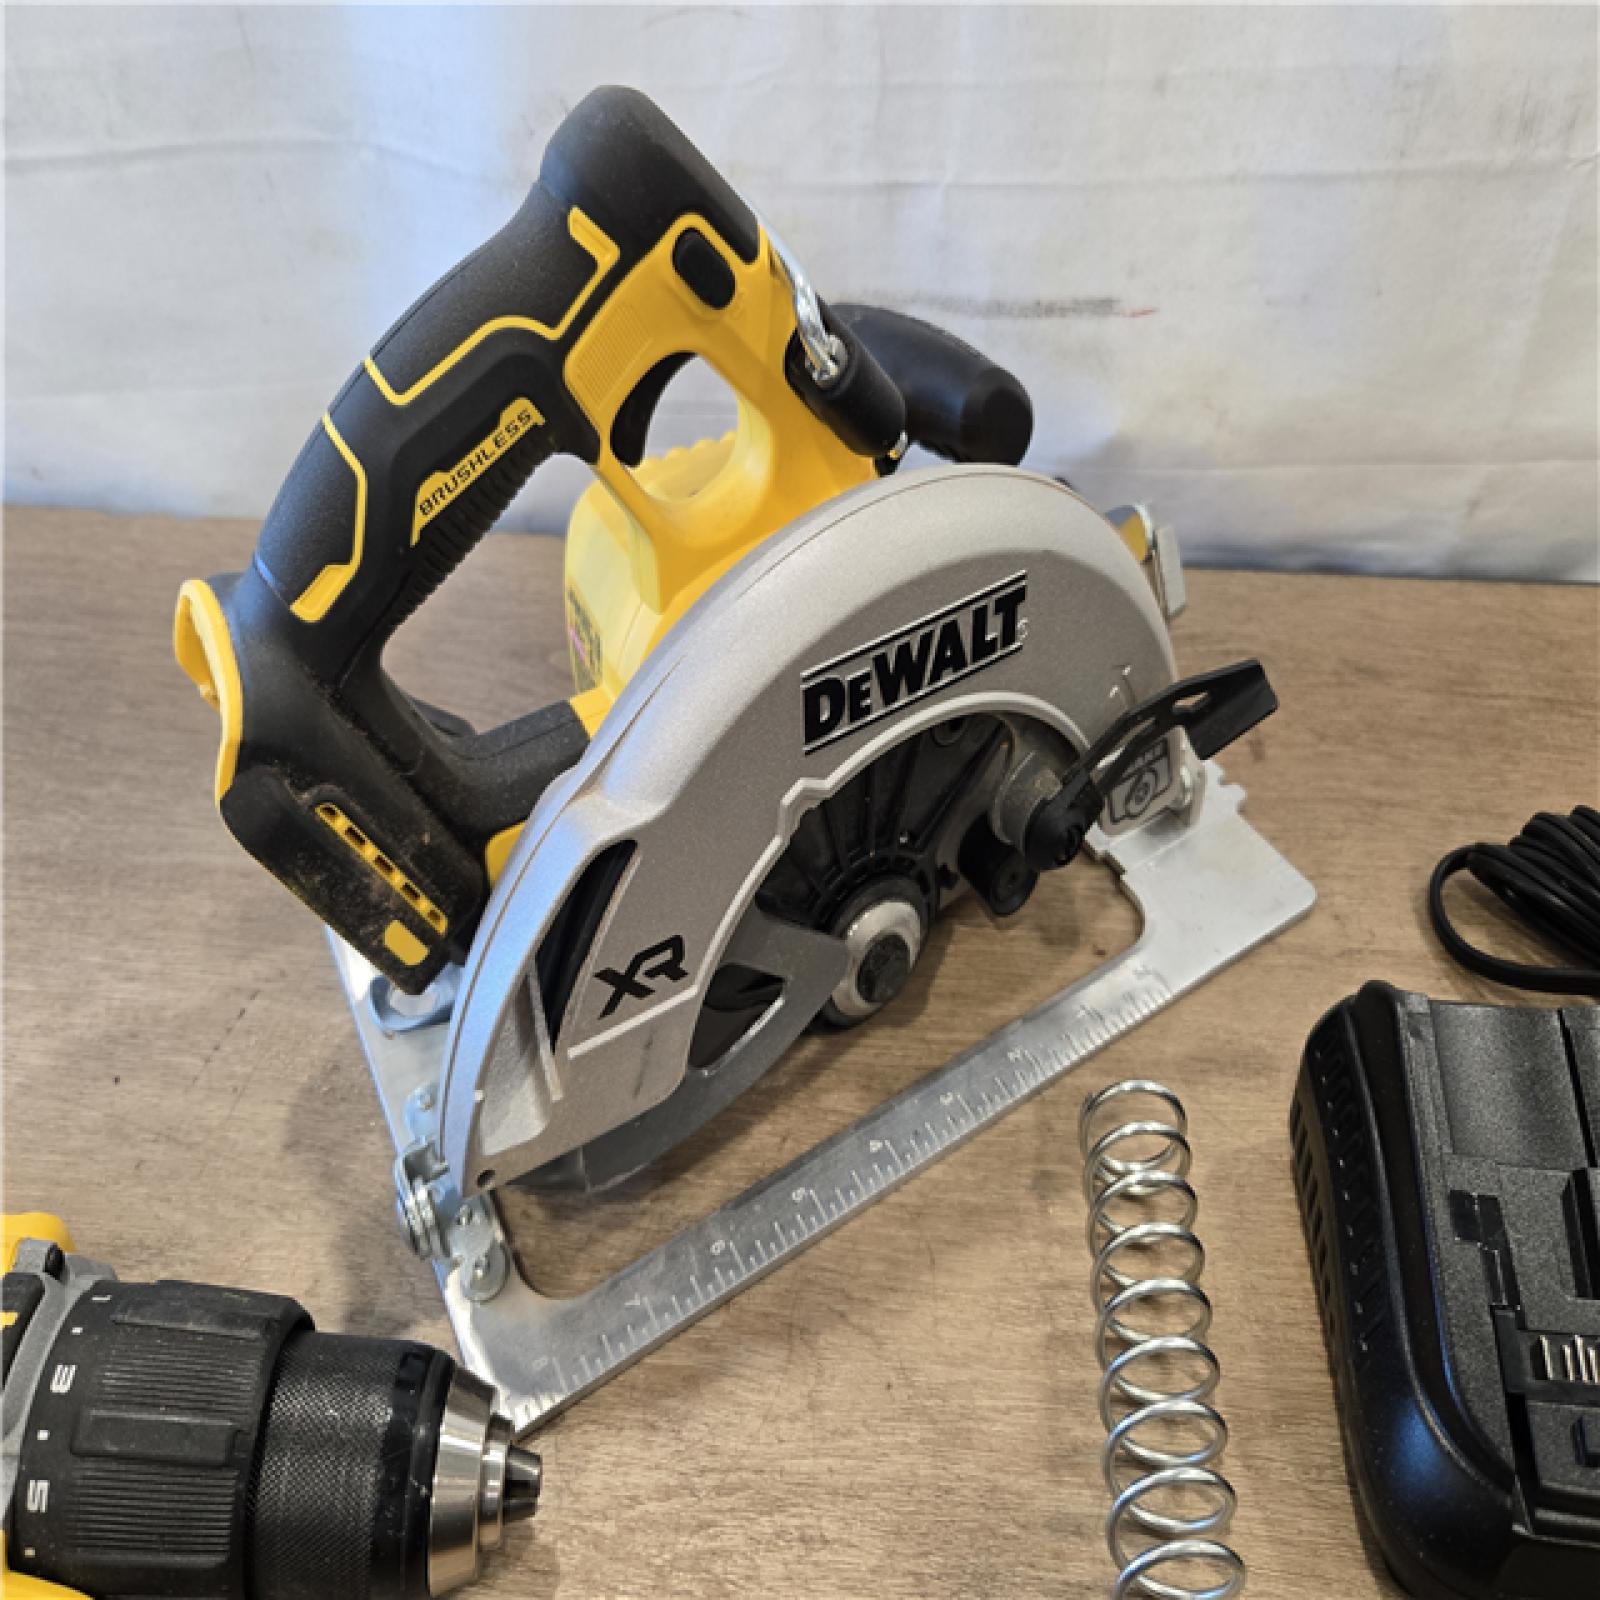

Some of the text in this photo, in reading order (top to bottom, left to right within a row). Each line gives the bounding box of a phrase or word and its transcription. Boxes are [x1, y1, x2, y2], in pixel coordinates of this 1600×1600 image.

[419, 408, 532, 516] BRUSHLESS
[593, 933, 689, 1020] XR
[27, 1479, 49, 1513] 5
